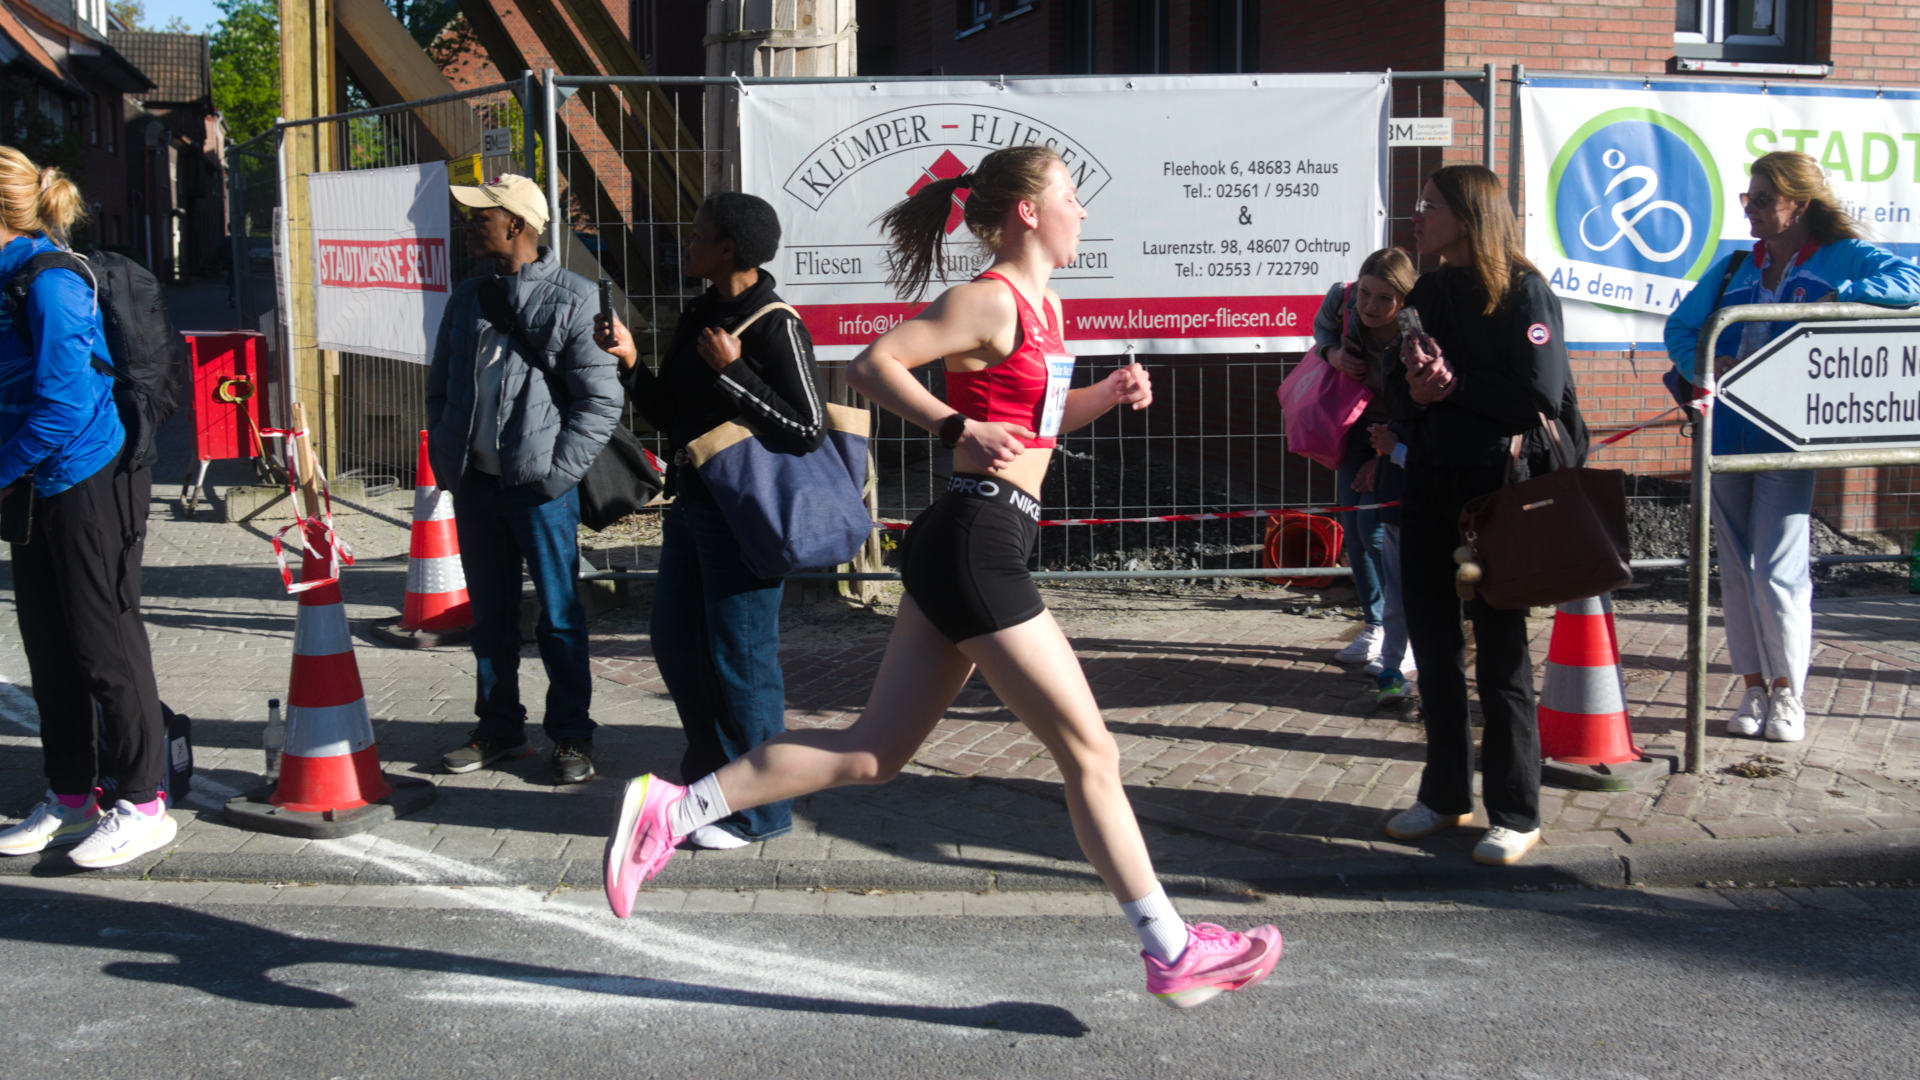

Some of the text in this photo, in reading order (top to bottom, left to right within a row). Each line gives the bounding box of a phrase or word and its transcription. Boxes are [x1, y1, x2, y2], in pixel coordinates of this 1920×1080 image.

[800, 114, 931, 198] KLÜMPER
[1163, 159, 1339, 177] Fleehook 6, 48683 Ahaus
[1183, 182, 1320, 199] Tel.: 02561 / 95430
[1238, 205, 1253, 226] &
[1874, 201, 1911, 223] ein
[1143, 238, 1351, 256] Laurenzstr. 98, 48607 Ochtrup
[406, 243, 446, 286] SELM
[795, 251, 862, 275] Fliesen
[1175, 261, 1319, 277] Tel.: 02553 / 722790
[1550, 266, 1580, 292] Ab
[1587, 272, 1633, 301] dem
[1645, 283, 1661, 306] 1.
[1076, 307, 1298, 334] www.kluemper-fliesen.de
[1807, 345, 1889, 380] Schloß
[1008, 489, 1041, 523] NIKE
